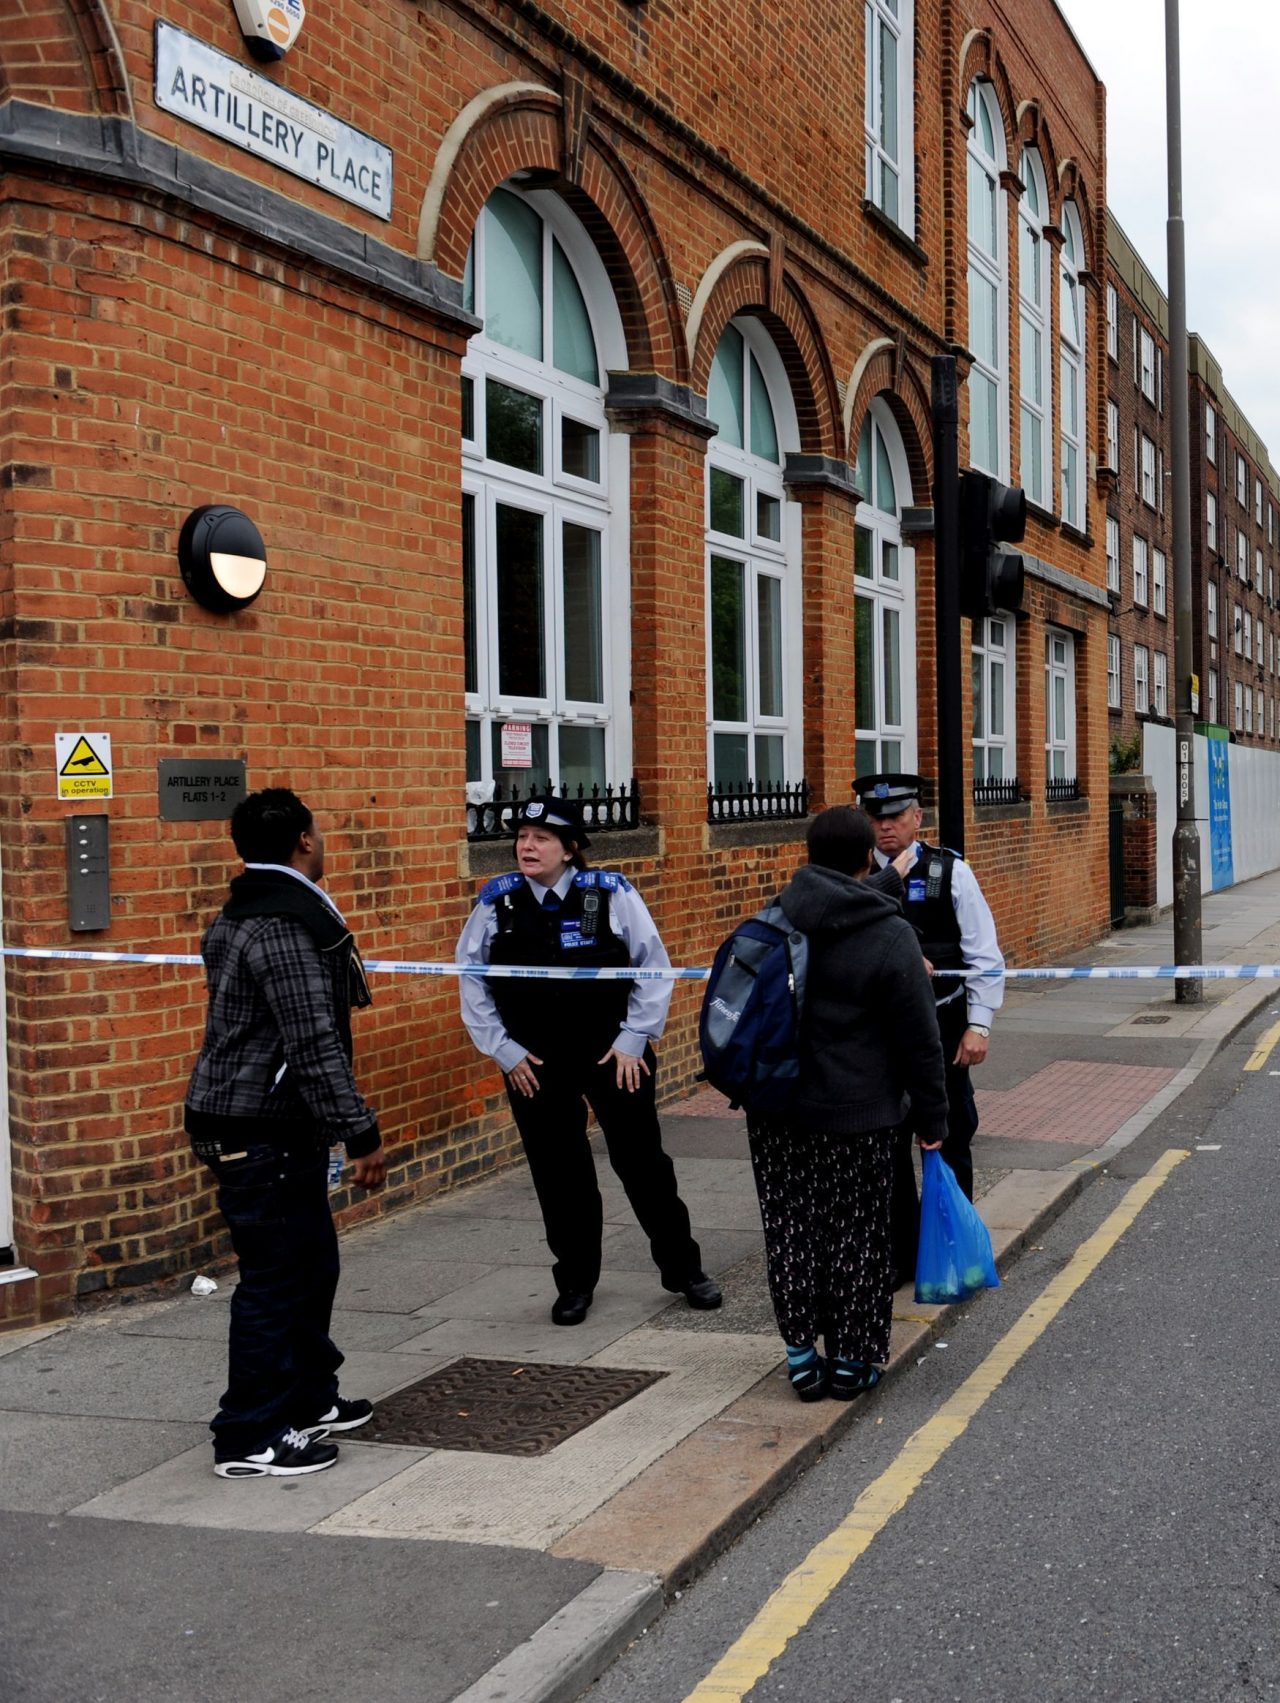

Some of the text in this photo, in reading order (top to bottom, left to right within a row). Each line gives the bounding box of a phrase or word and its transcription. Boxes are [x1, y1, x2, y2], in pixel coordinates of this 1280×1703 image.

[170, 65, 382, 201] ARTILLERY PLACE
[73, 780, 97, 788] CCTV
[167, 776, 240, 787] ARTILLERY PLACE
[70, 787, 109, 795] operation
[182, 791, 226, 803] FLATS 1-2
